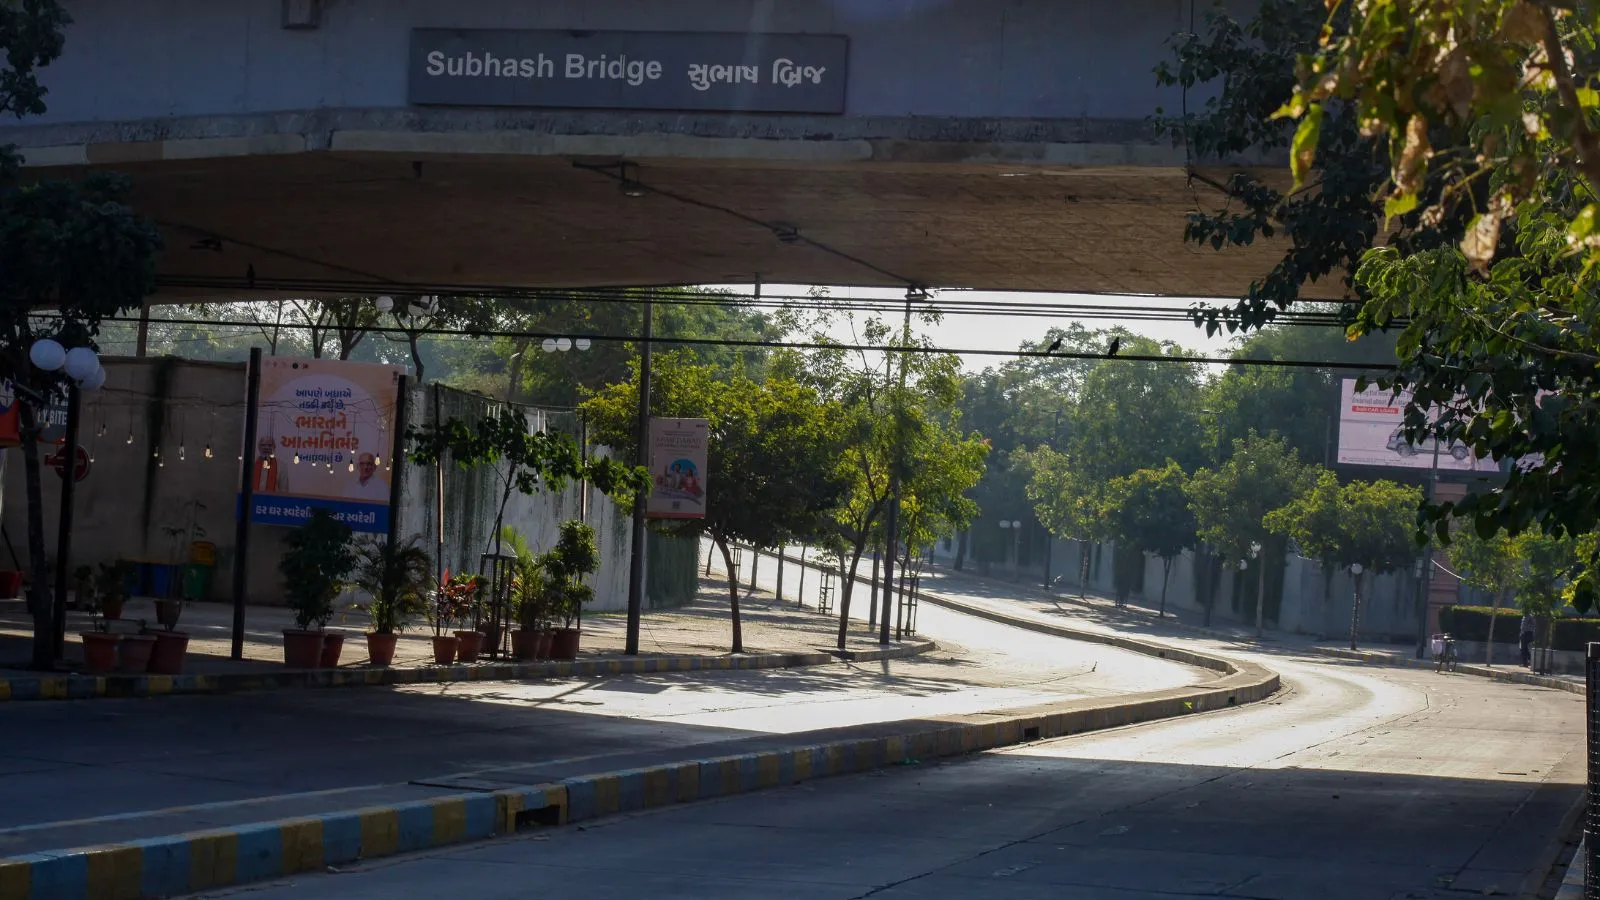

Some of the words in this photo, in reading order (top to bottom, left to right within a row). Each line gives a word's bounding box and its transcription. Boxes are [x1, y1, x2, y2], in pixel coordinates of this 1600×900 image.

[427, 50, 554, 78] Subhash
[565, 53, 663, 86] Bridge
[687, 63, 759, 91] સુભાષ
[772, 57, 827, 88] બ્રિજ
[295, 387, 323, 398] આપણે
[295, 411, 347, 429] ભારતને
[279, 430, 360, 450] આત્મનિર્ભર
[346, 511, 376, 524] સ્વદેશી
